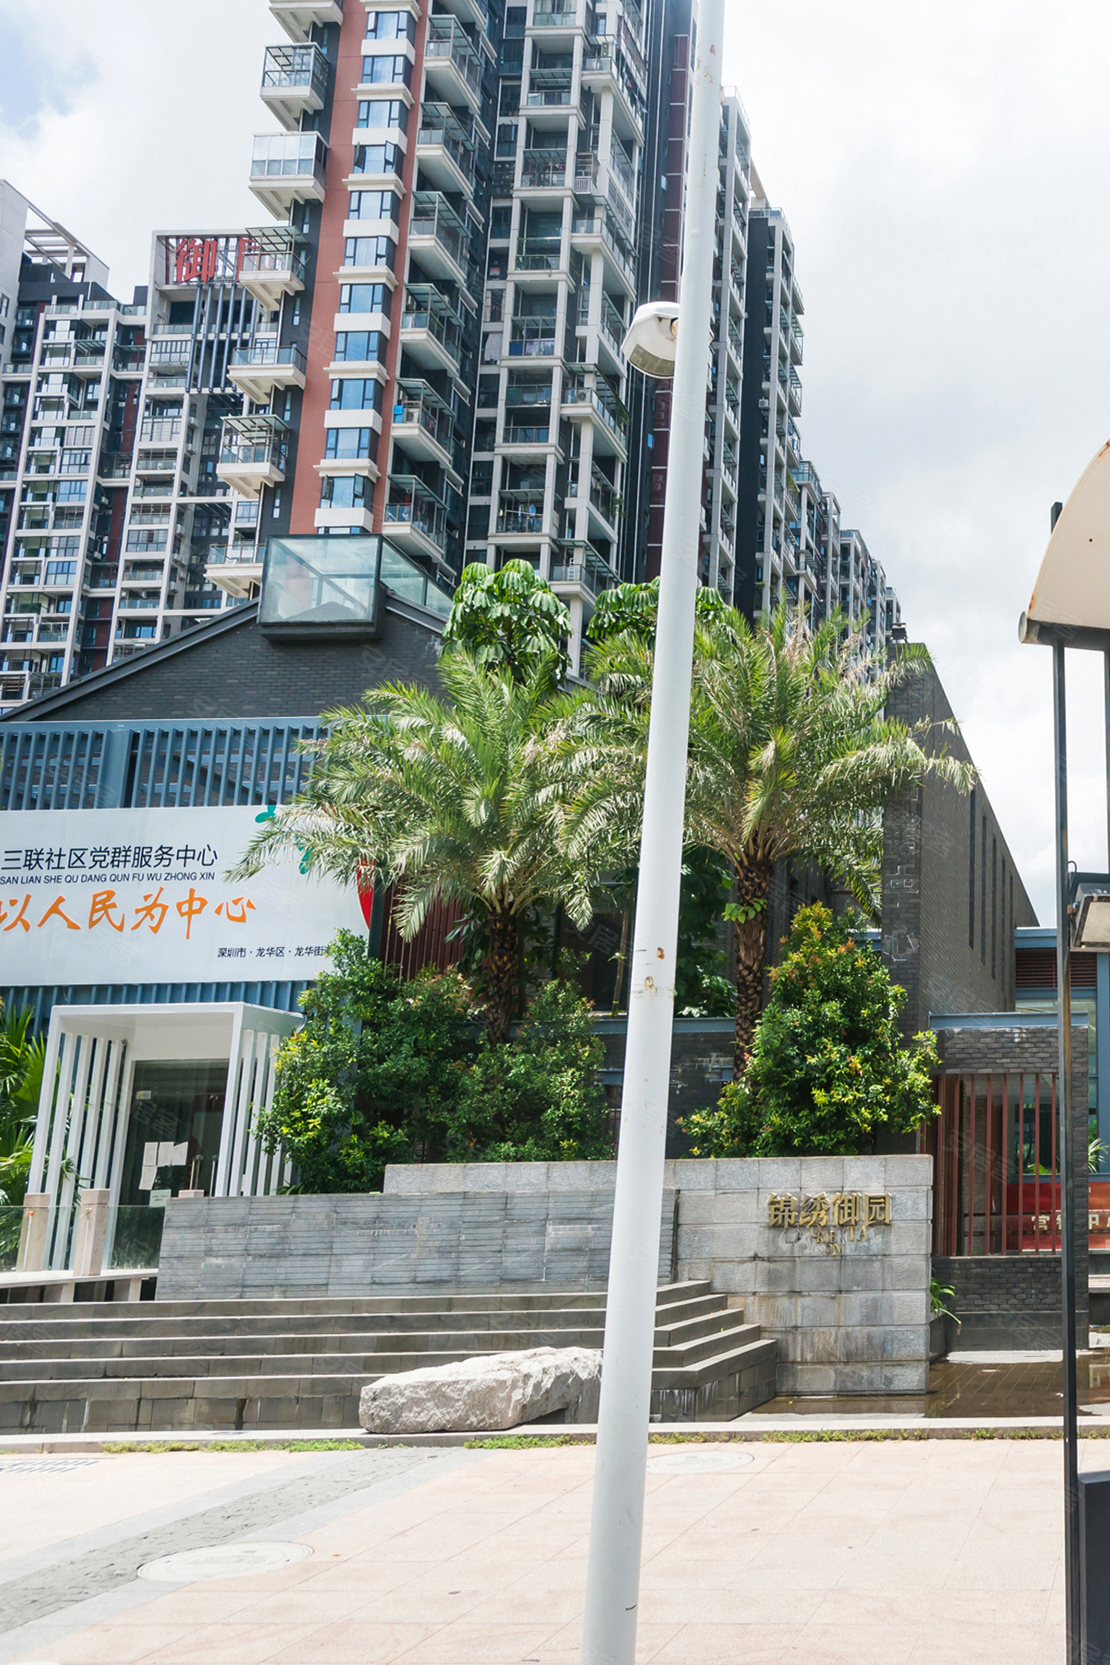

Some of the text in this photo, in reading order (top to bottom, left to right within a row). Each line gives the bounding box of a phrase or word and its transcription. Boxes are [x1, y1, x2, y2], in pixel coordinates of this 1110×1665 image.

[1, 844, 218, 871] 三联社区党群服务中心
[0, 871, 215, 885] SAN LIAN SHE QU DANG QUN FU WU ZHONG XIN
[0, 886, 257, 940] 以人民为中心
[767, 1191, 893, 1228] 锦绣御园
